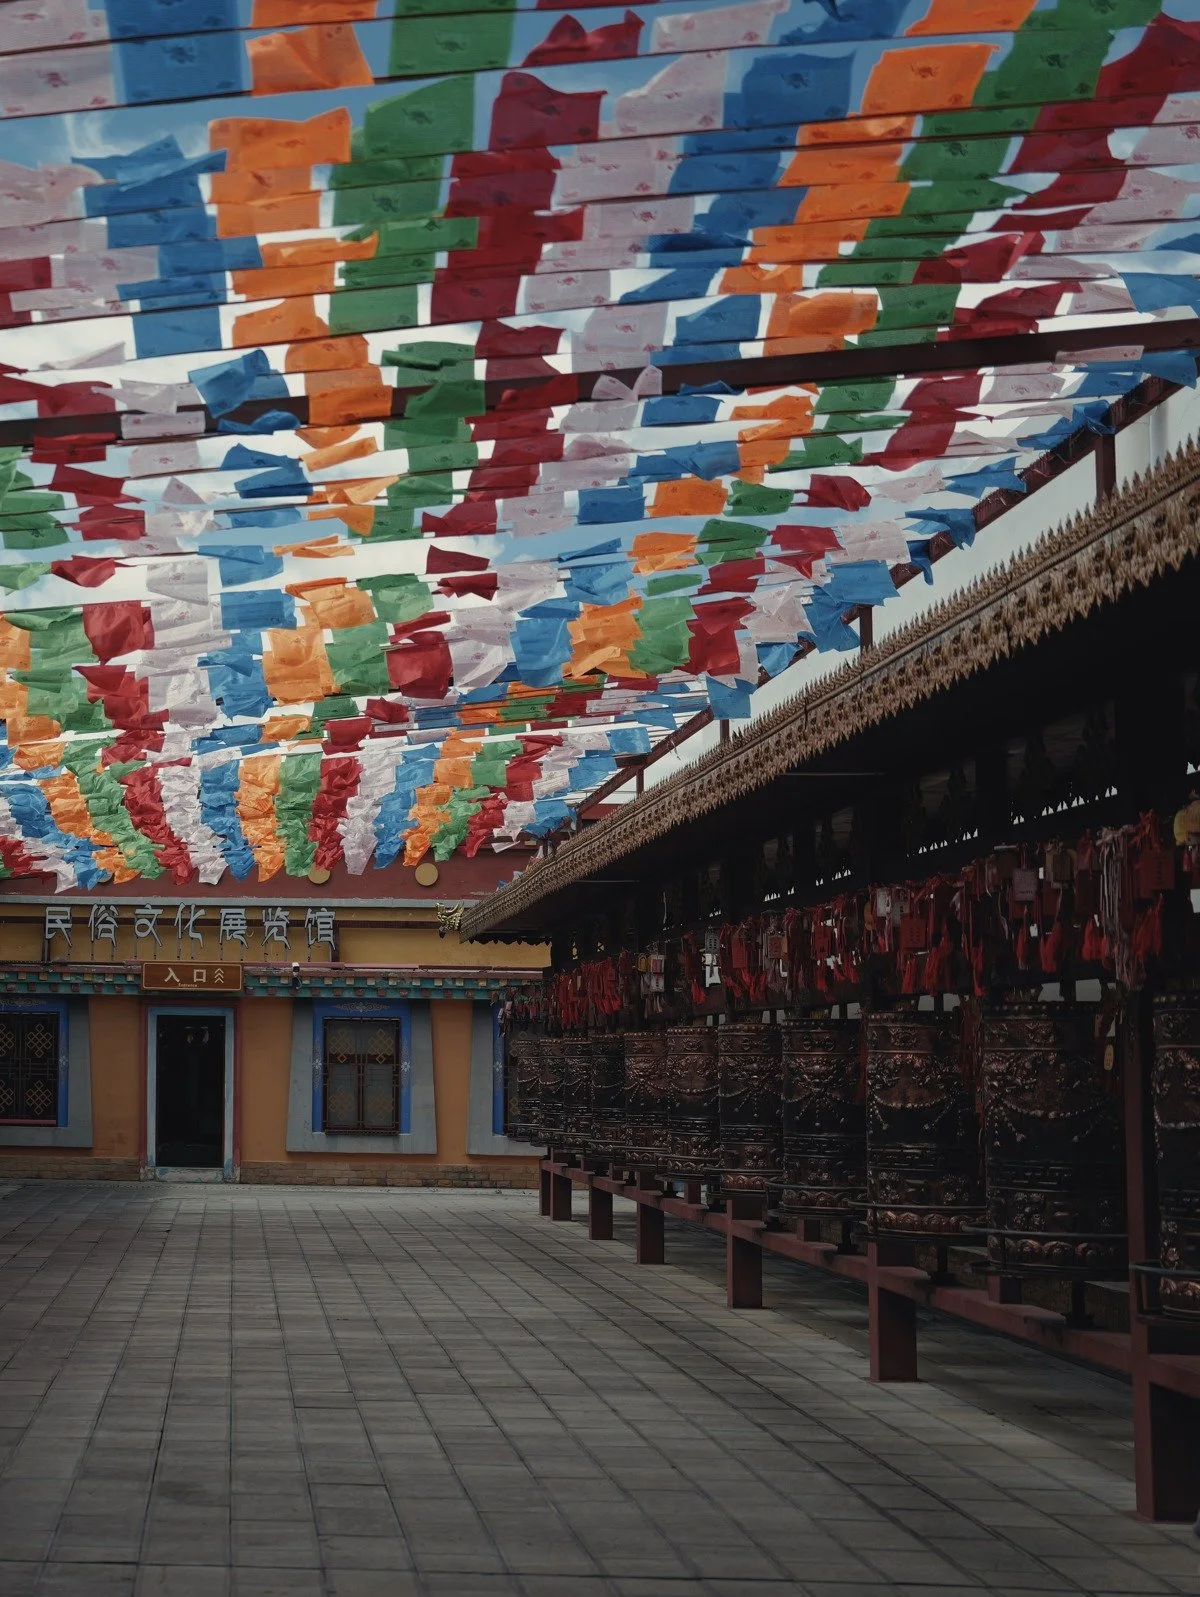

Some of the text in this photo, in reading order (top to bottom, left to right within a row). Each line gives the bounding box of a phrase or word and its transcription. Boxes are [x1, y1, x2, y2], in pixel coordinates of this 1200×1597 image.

[44, 902, 337, 951] 民俗文化展览馆
[164, 967, 206, 982] 入口
